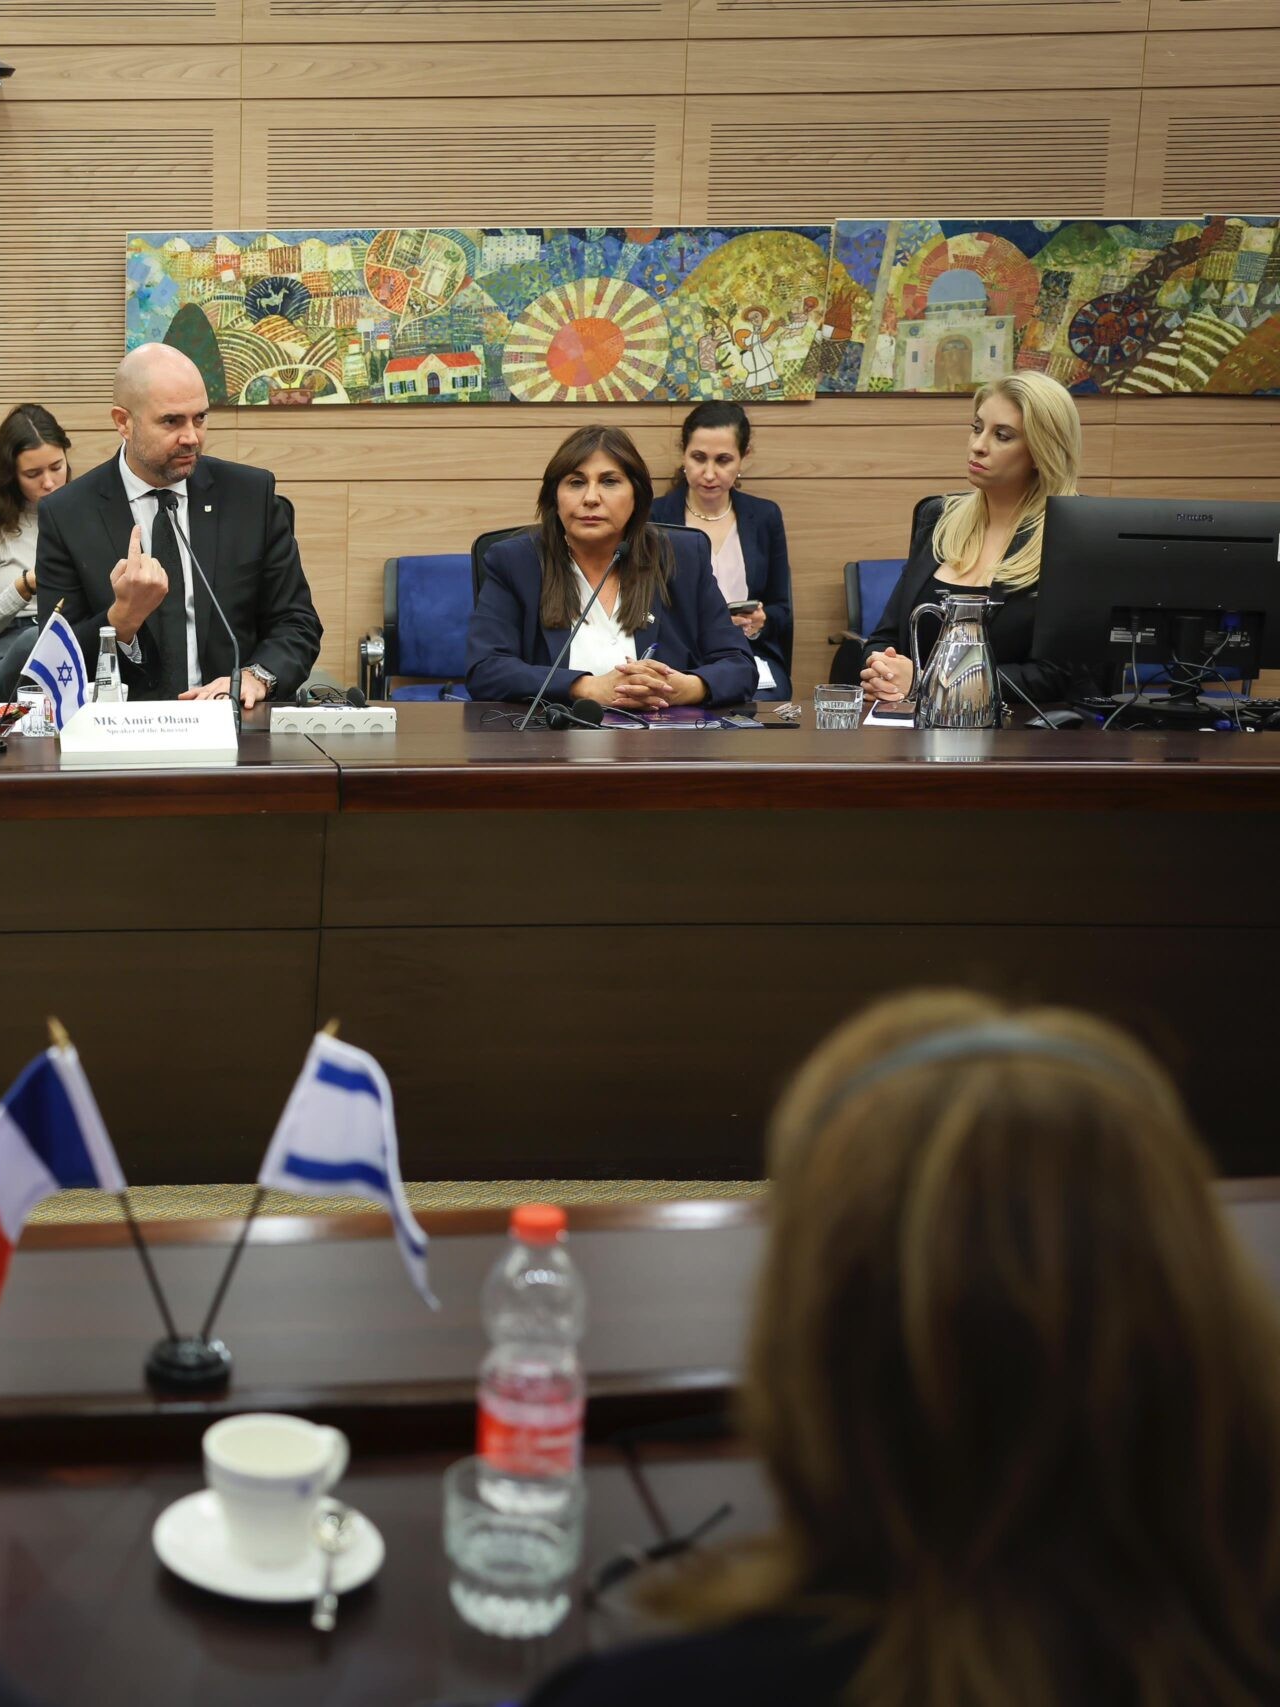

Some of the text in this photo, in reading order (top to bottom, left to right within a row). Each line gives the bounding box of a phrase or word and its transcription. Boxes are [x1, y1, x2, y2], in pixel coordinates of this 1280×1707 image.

[93, 714, 199, 726] MK Amir Ohana
